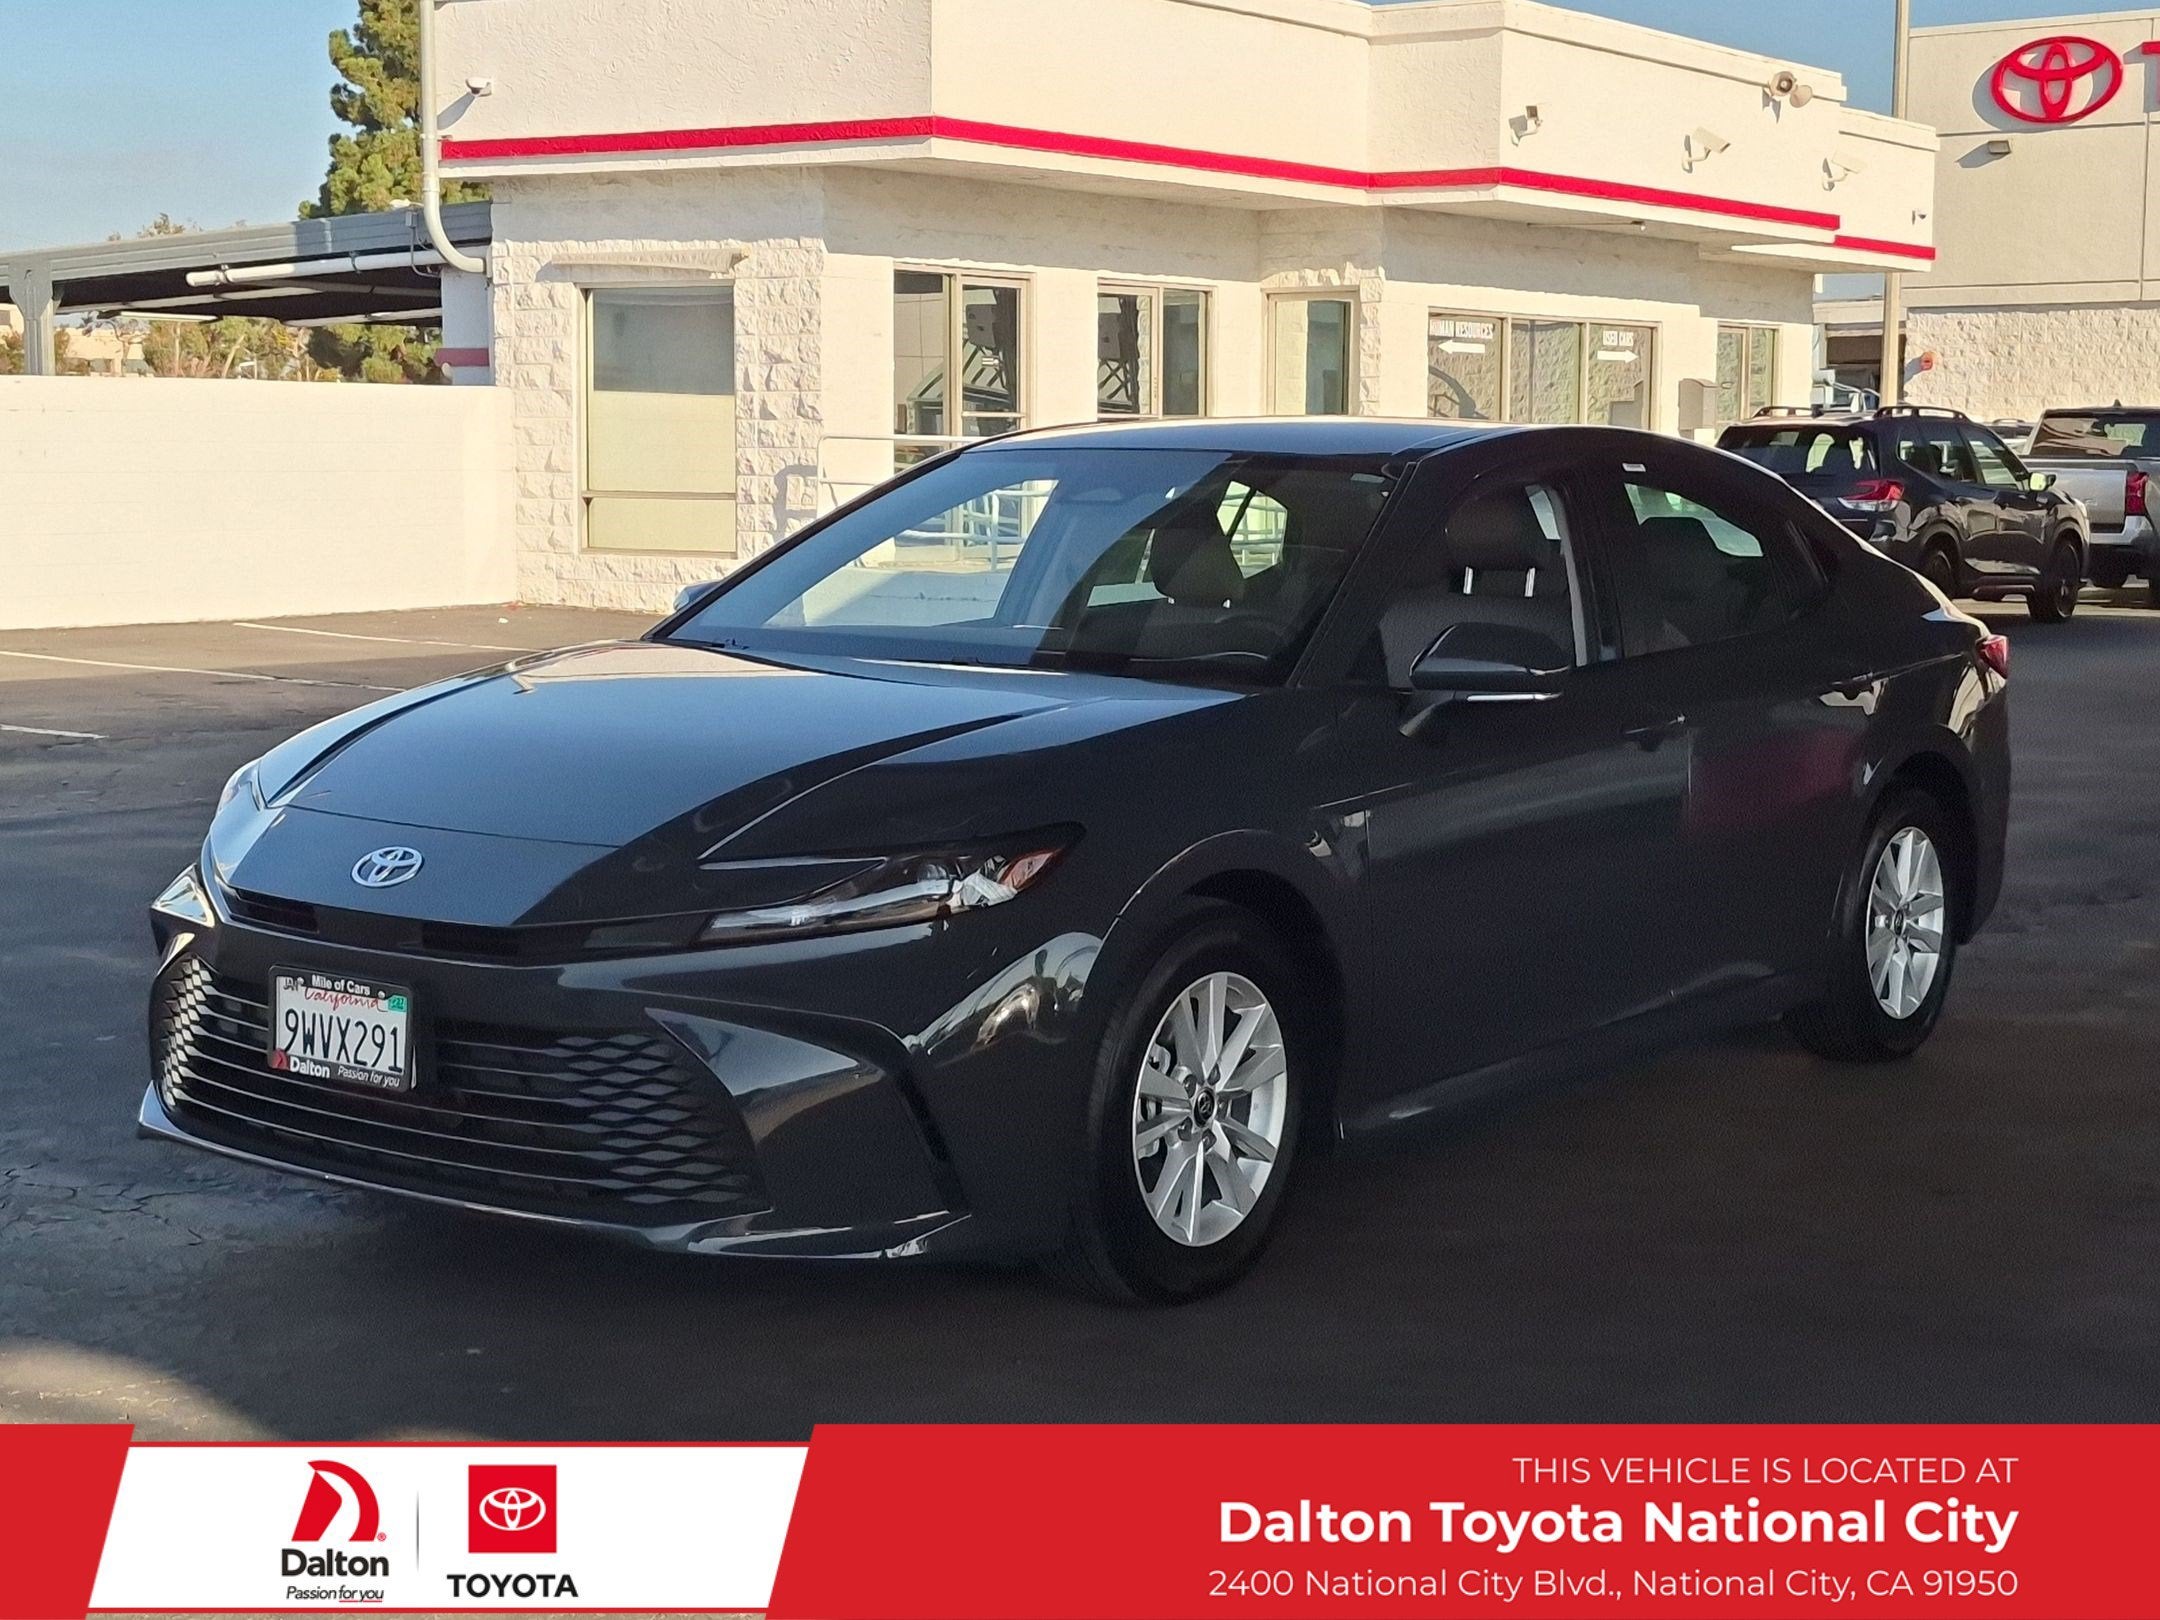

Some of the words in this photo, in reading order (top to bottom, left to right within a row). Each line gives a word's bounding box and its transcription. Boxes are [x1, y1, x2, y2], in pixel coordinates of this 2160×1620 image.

[312, 974, 332, 990] Mile
[334, 979, 345, 991] of
[346, 980, 370, 996] Cars
[305, 986, 379, 1011] California
[285, 1008, 403, 1074] 9WVX291
[289, 1056, 330, 1079] Dalton
[338, 1065, 369, 1081] Passion
[370, 1070, 384, 1083] for
[383, 1075, 401, 1088] you
